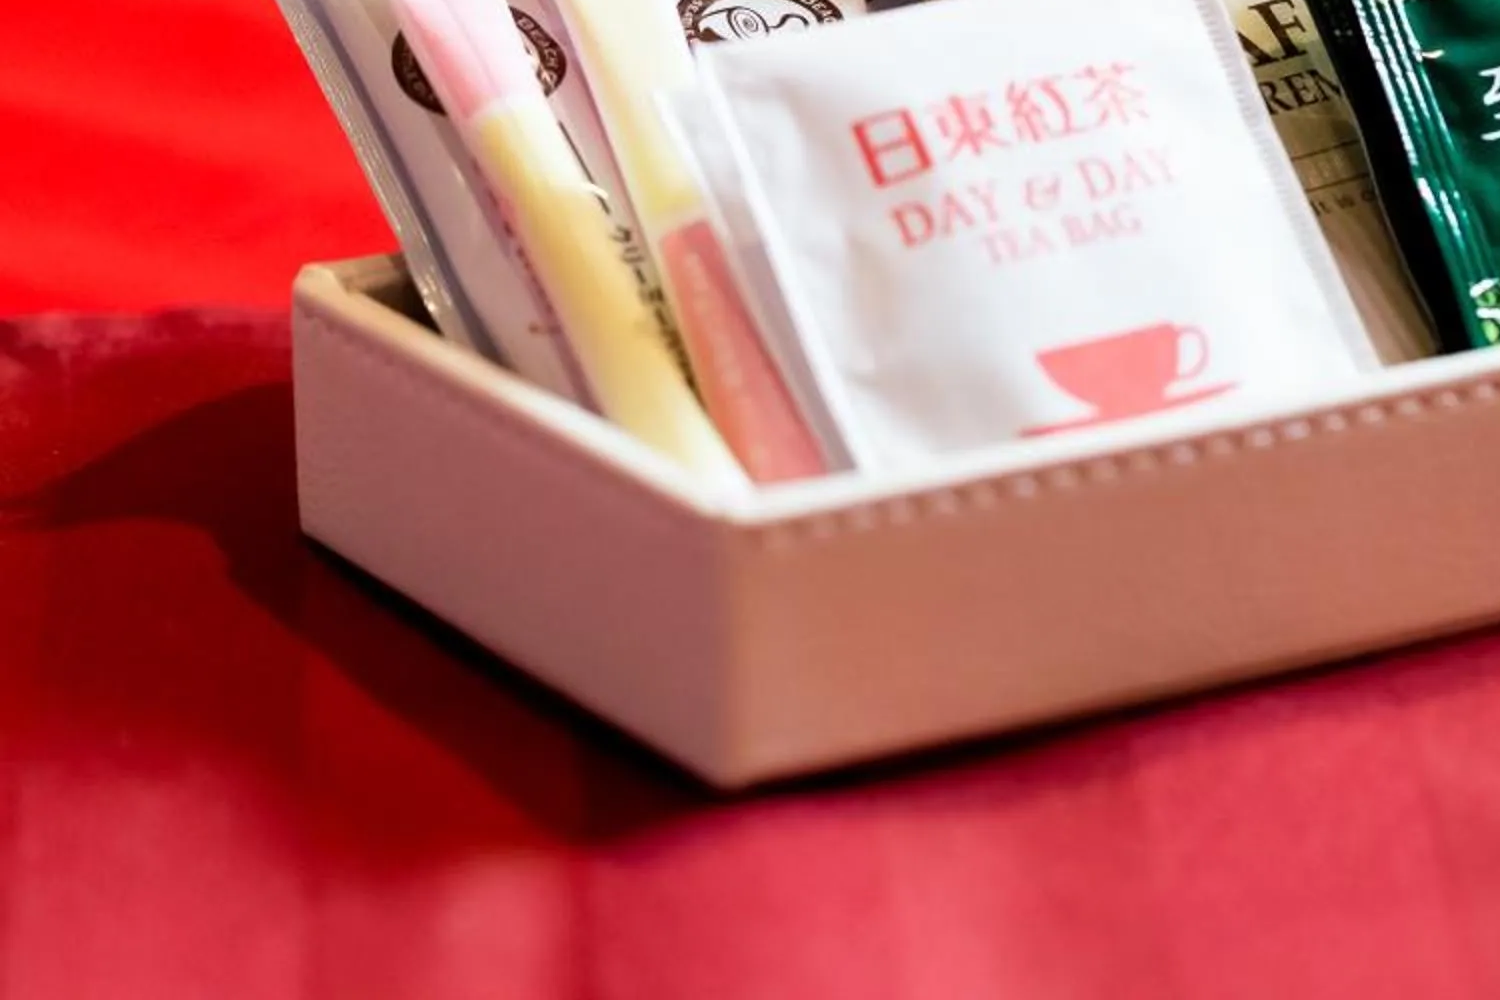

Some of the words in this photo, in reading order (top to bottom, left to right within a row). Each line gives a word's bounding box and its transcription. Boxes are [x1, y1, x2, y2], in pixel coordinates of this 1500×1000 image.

[850, 60, 1150, 190] 日東紅茶
[889, 178, 1001, 249] DAY
[1076, 146, 1179, 203] DAY
[1059, 200, 1146, 247] BAG
